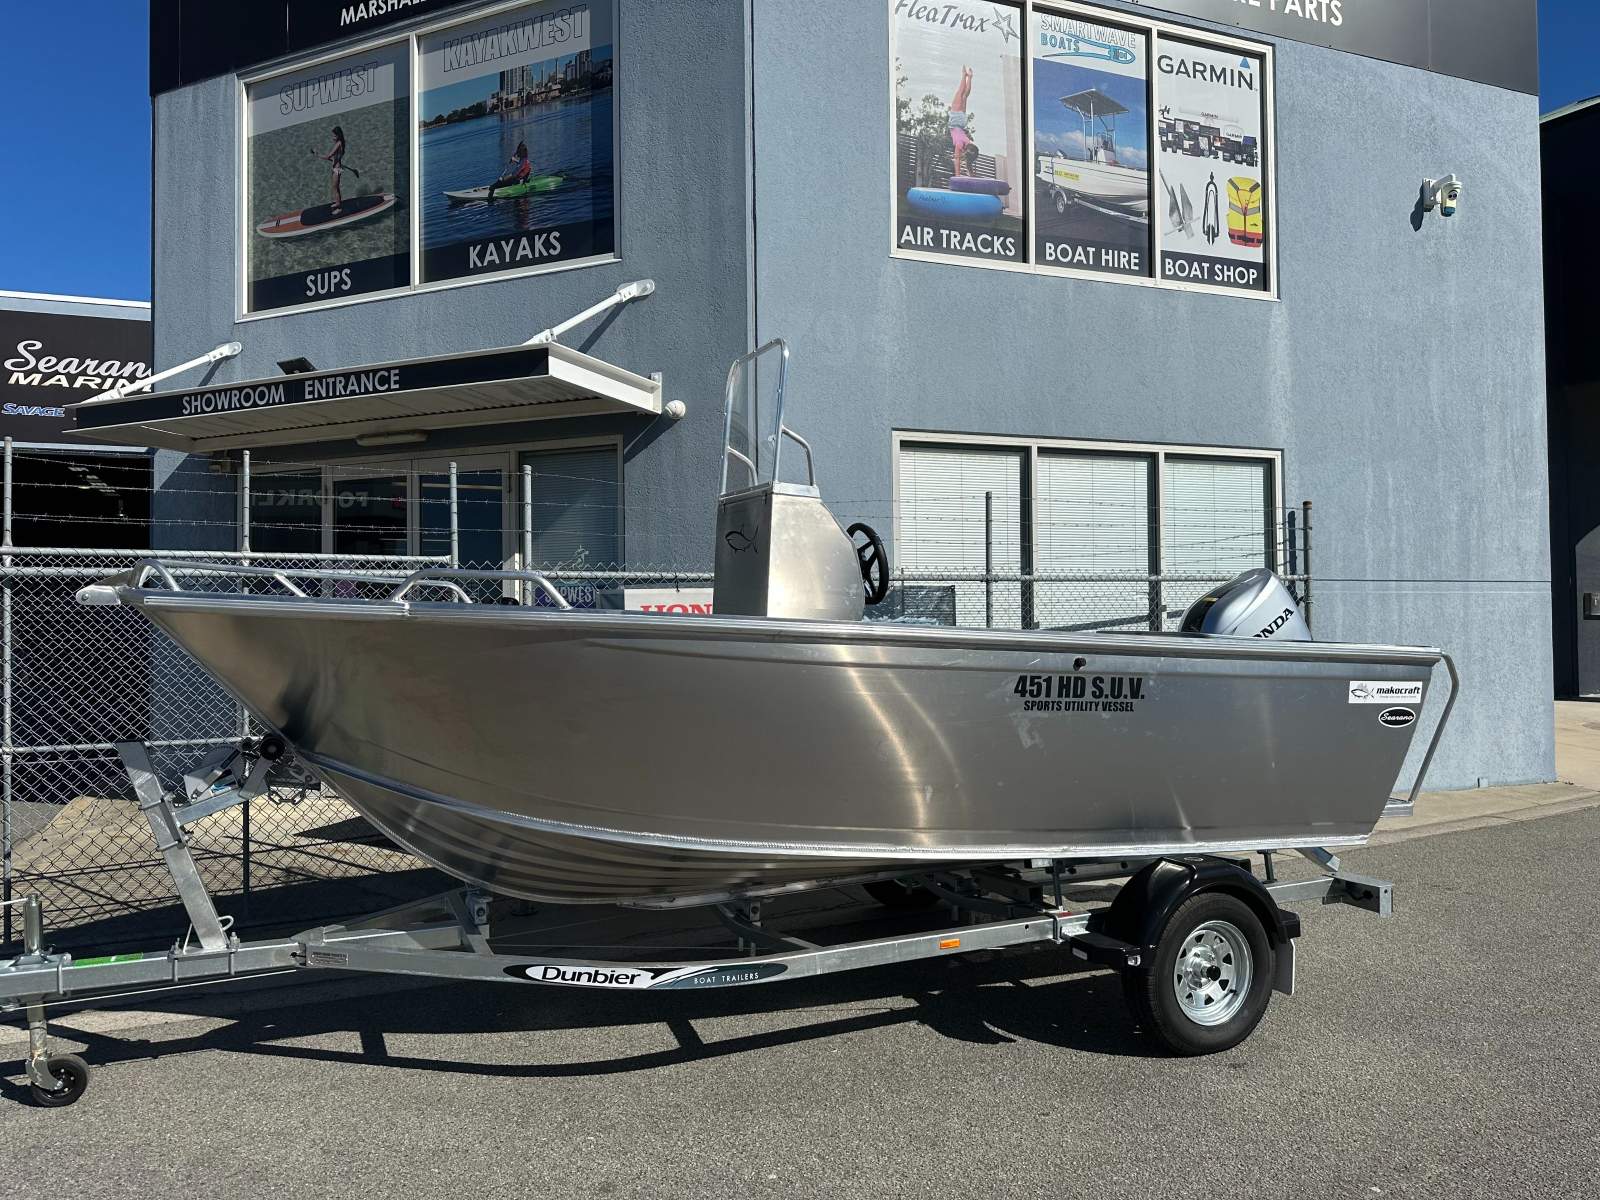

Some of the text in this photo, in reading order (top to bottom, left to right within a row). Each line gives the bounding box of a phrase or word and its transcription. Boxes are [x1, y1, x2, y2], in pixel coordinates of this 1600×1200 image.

[443, 4, 586, 72] KAYAKWEST
[1041, 14, 1136, 48] SMARTWAVE
[1041, 33, 1079, 52] BOATS
[1157, 54, 1253, 91] GARMIN
[280, 61, 378, 115] SUPWEST
[468, 232, 561, 269] KAYAKS
[900, 225, 1016, 257] AIR TRACKS
[1045, 242, 1139, 270] BOAT HIRE
[305, 269, 352, 297] SUPS
[1165, 259, 1258, 284] BOAT SHOP
[4, 340, 151, 378] Searan
[182, 369, 400, 415] SHOWROOM ENTRANCE
[2, 403, 66, 417] SAVAGE
[1014, 675, 1145, 699] 451 HD S.U.V.
[1377, 686, 1420, 695] makocraft
[1024, 700, 1134, 712] SPORTS UTILITY VESSEL
[541, 966, 641, 985] Dunbier
[694, 972, 760, 985] BOAT TRAILERS
